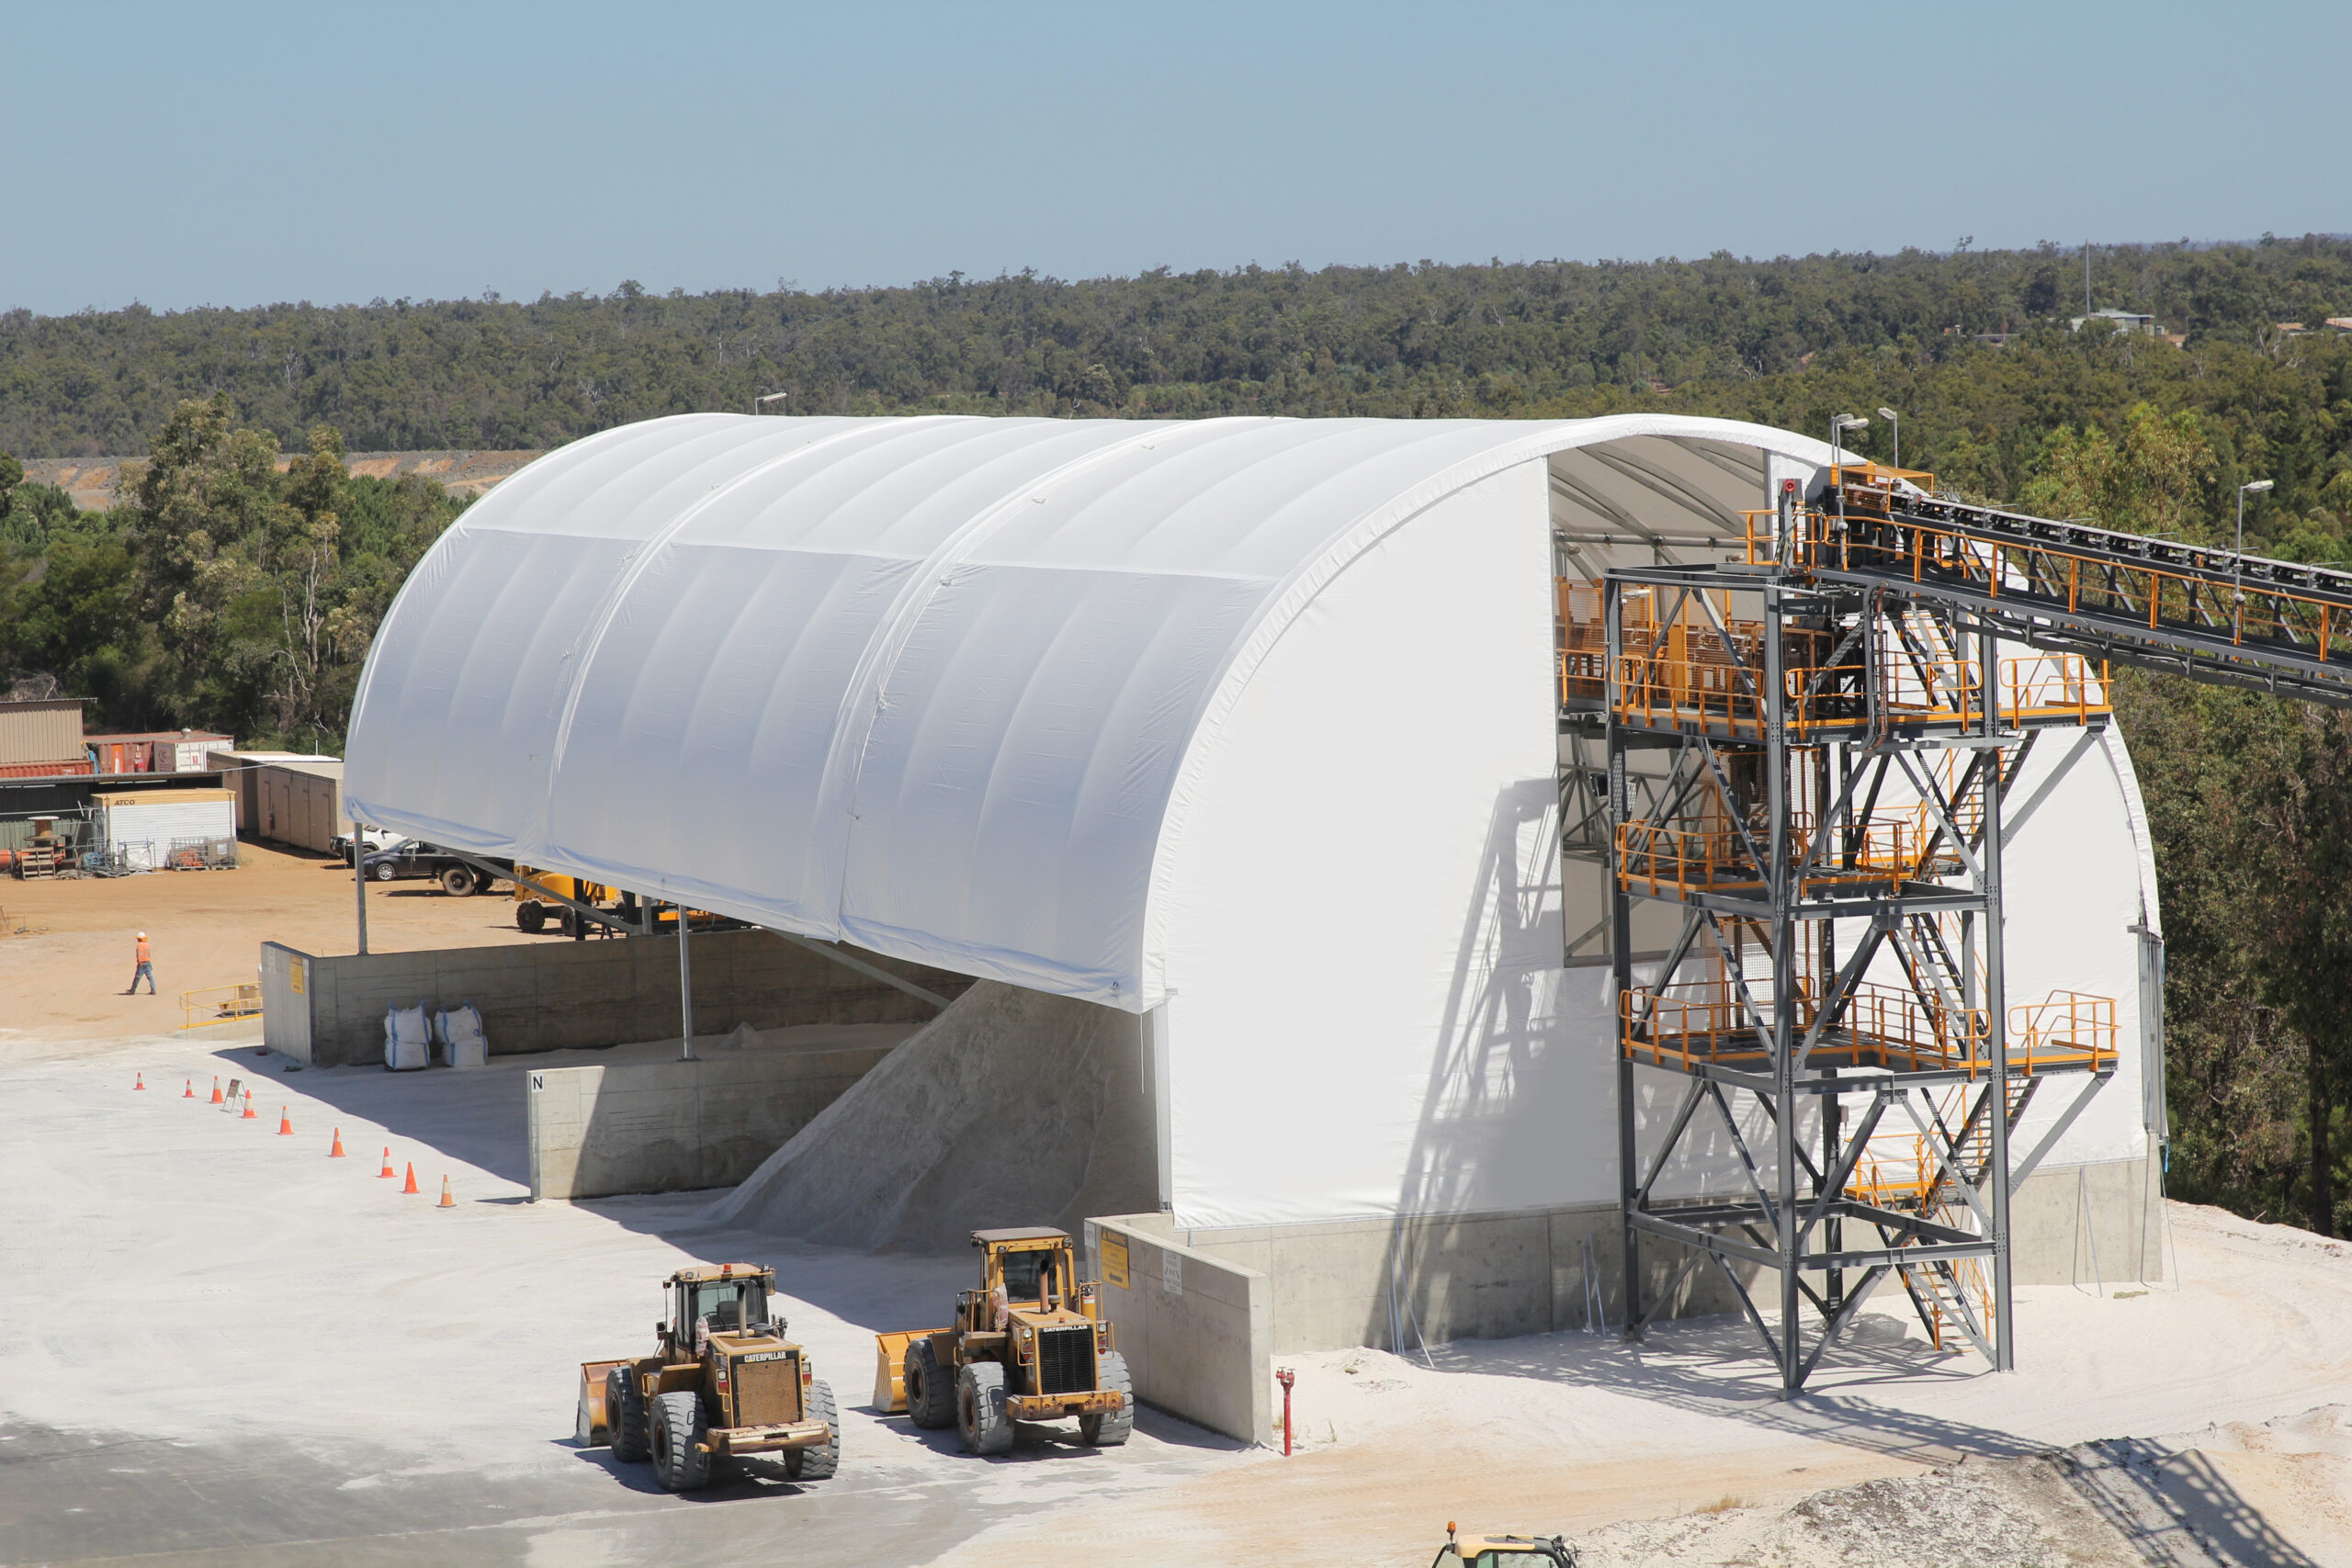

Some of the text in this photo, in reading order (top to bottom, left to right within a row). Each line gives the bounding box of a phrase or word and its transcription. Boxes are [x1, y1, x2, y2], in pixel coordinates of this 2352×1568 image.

[533, 1076, 543, 1089] N
[1043, 1325, 1088, 1333] CATERPILLAR
[744, 1351, 786, 1363] CATERPILLAR
